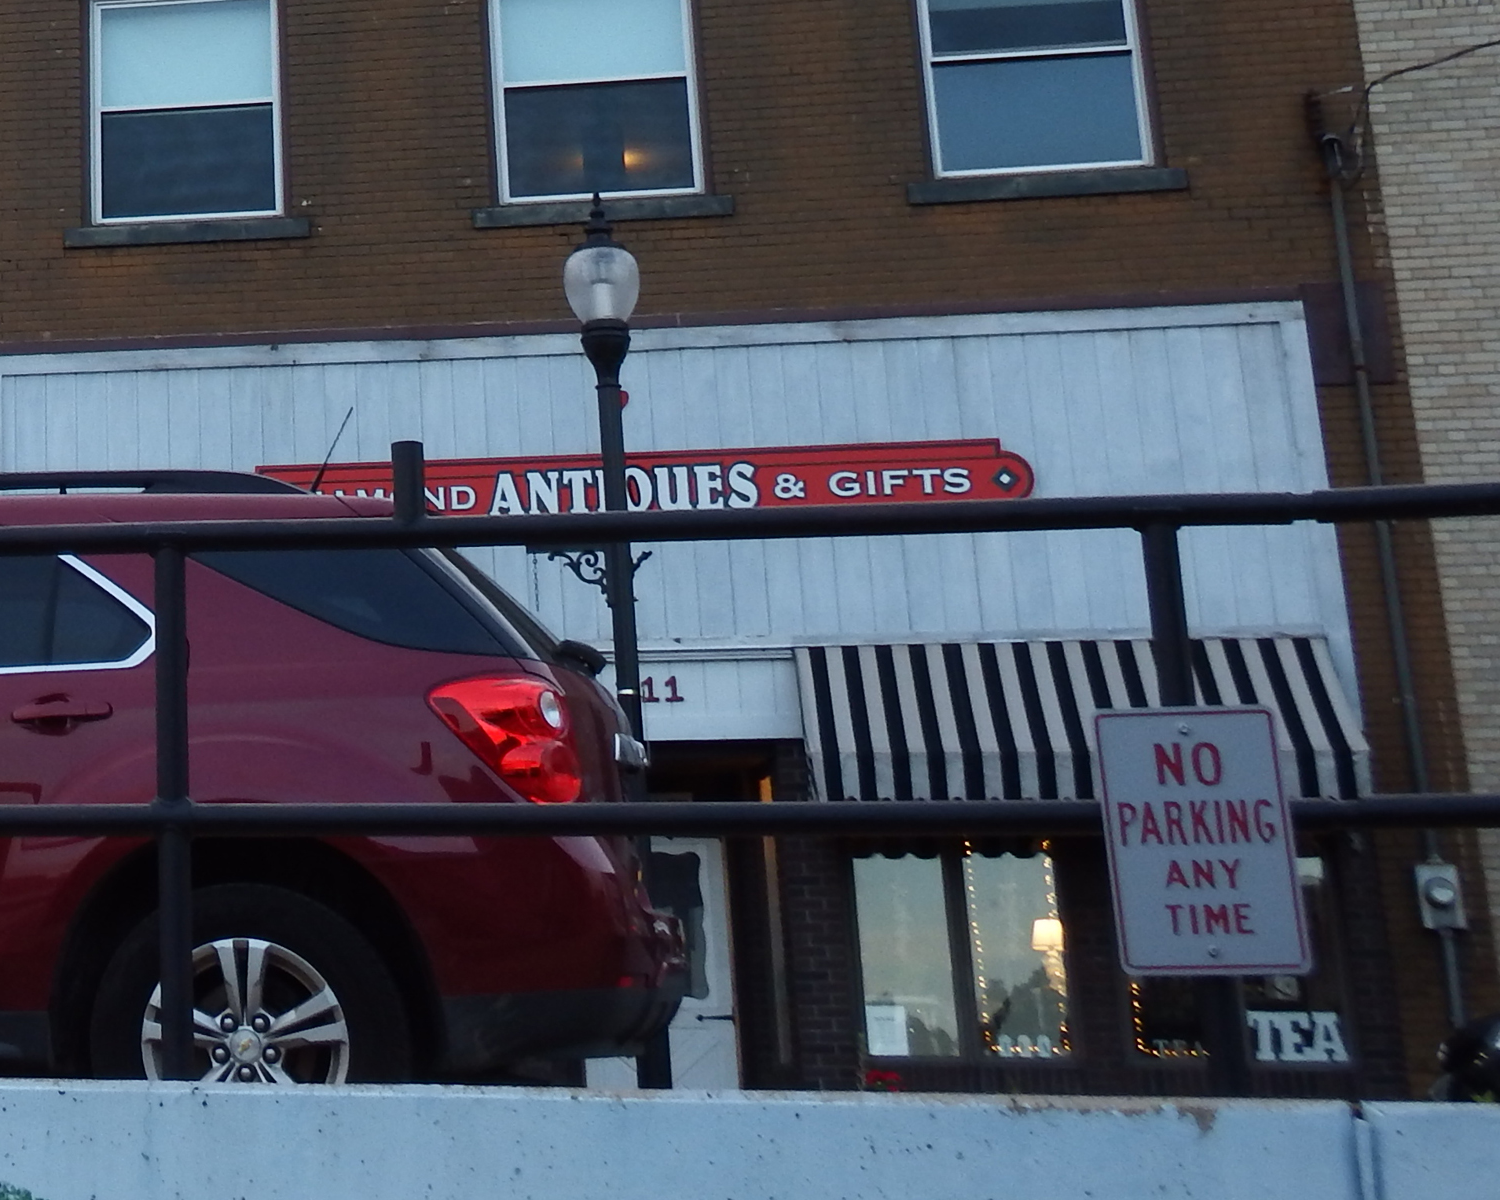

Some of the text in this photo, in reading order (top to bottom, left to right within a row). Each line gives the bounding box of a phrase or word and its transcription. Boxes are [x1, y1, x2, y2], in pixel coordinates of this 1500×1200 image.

[773, 473, 806, 500] &
[828, 467, 972, 498] GIFTS
[1153, 741, 1223, 787] NO
[1116, 798, 1278, 847] PARKING
[1164, 858, 1242, 890] ANY
[1164, 903, 1256, 936] TIME
[1246, 1009, 1349, 1062] TEA
